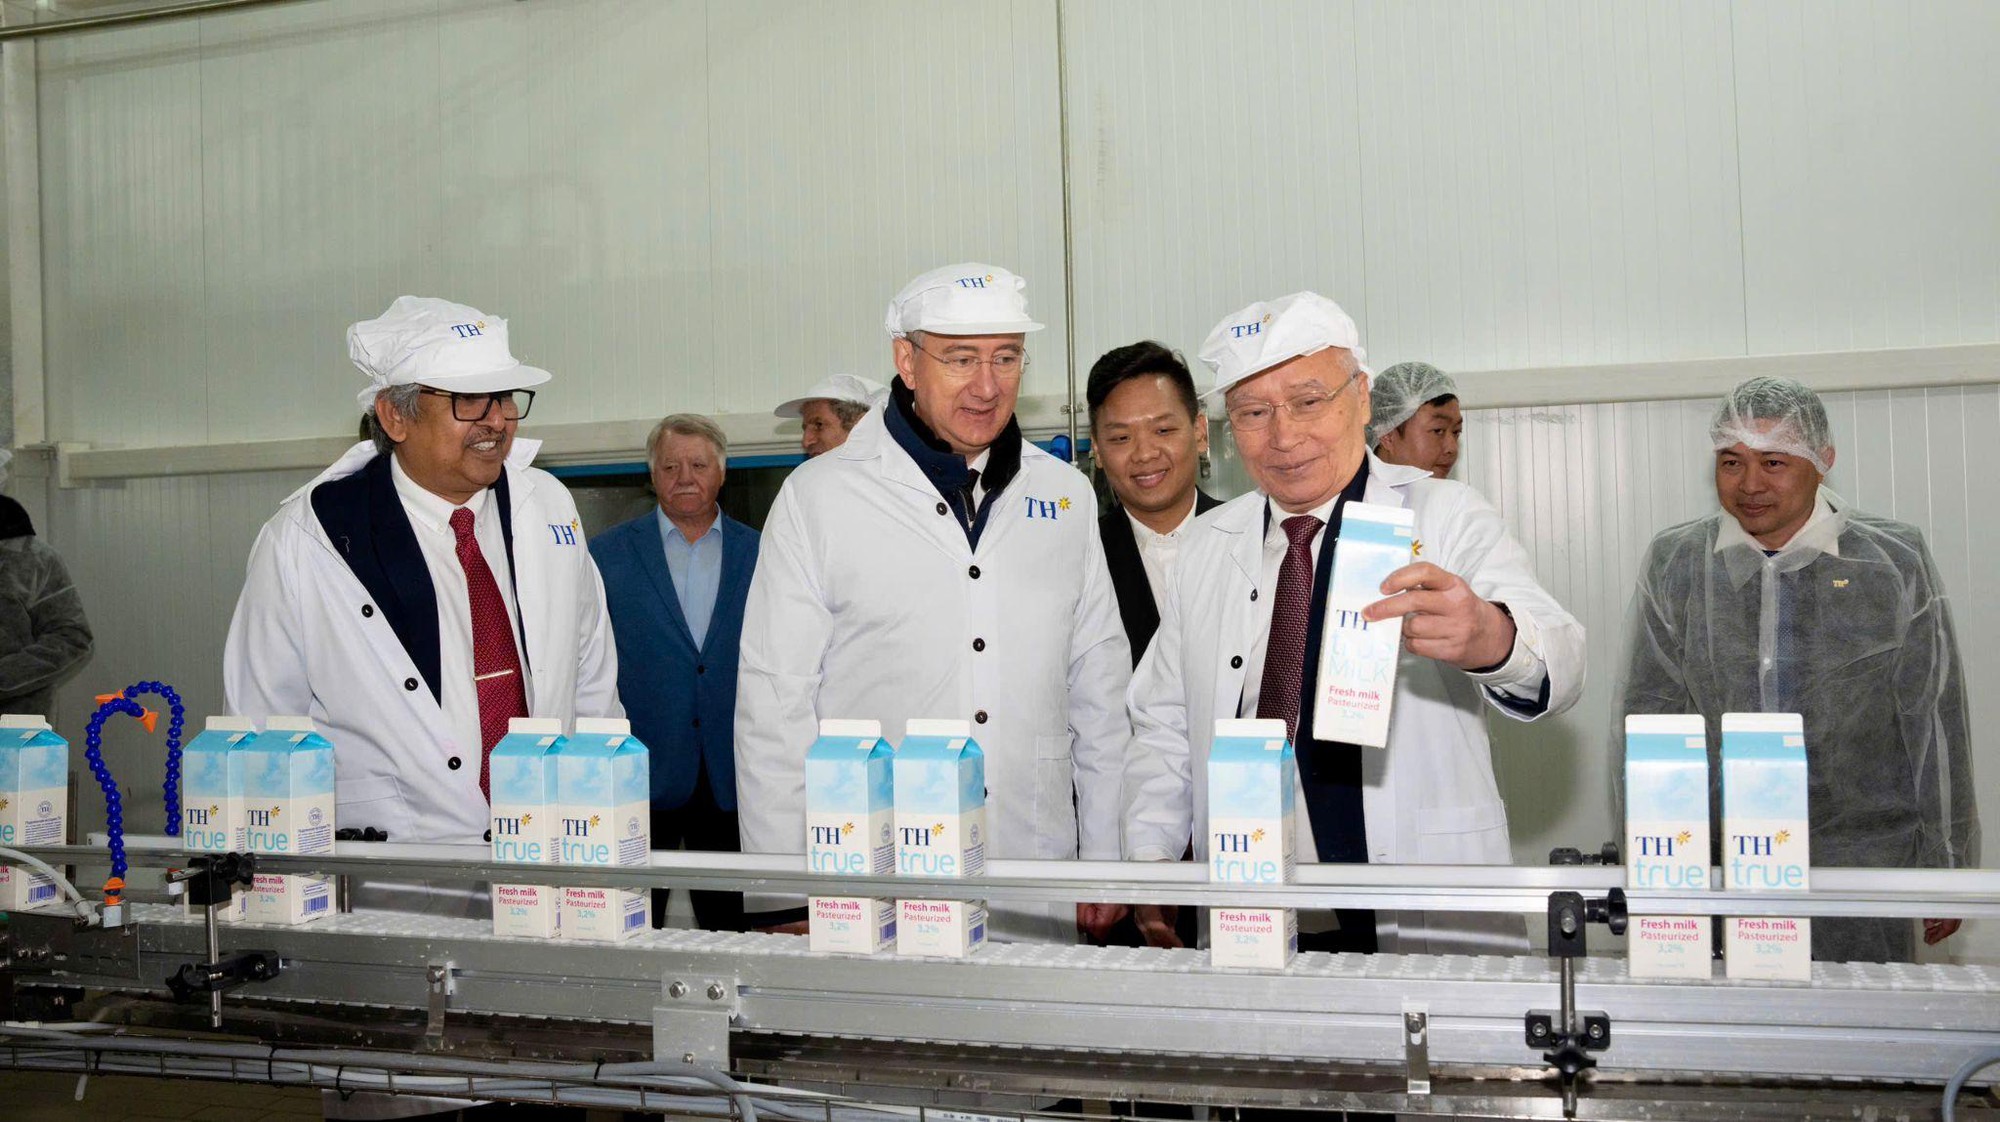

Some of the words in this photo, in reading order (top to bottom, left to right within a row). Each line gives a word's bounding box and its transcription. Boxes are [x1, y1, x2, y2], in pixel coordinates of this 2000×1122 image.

[955, 277, 987, 288] TH
[451, 324, 483, 338] TH
[1231, 321, 1261, 338] TH
[1024, 496, 1058, 520] TH
[548, 524, 576, 545] TH
[1329, 685, 1356, 698] Fresh
[1358, 690, 1380, 701] milk
[1327, 696, 1380, 711] Pasteurized
[186, 808, 208, 825] TH
[247, 810, 269, 826] TH
[494, 817, 520, 835] TH
[562, 818, 589, 837] TH
[185, 826, 226, 849] true
[246, 827, 288, 851] true
[811, 826, 841, 845] TH
[900, 827, 930, 846] TH
[1215, 833, 1249, 852] TH
[494, 836, 541, 861] true
[562, 838, 609, 863] true
[1635, 836, 1674, 856] TH
[1733, 835, 1773, 856] TH
[811, 846, 865, 873] true
[899, 847, 956, 873] true
[1214, 854, 1277, 883] true
[1634, 858, 1704, 887] true
[1731, 857, 1803, 886] true
[253, 876, 268, 885] resh
[268, 876, 285, 885] milk
[498, 887, 519, 896] Fresh
[519, 888, 537, 897] milk
[566, 888, 586, 898] Fresh
[587, 890, 605, 899] milk
[498, 897, 538, 906] Pasteurized
[566, 898, 606, 909] Pasteurized
[816, 900, 839, 910] Fresh
[840, 900, 860, 911] milk
[904, 901, 928, 912] Fresh
[930, 903, 950, 913] milk
[816, 910, 861, 921] Pasteurized
[904, 913, 951, 923] Pasteurized
[1219, 911, 1247, 922] Fresh
[1249, 913, 1272, 923] milk
[1219, 923, 1272, 933] Pasteurized
[1640, 919, 1671, 929] Fresh
[1674, 920, 1698, 930] milk
[1738, 918, 1769, 930] Fresh
[1772, 920, 1797, 931] milk
[1640, 931, 1699, 941] Pasteurized
[1738, 931, 1798, 942] Pasteurized
